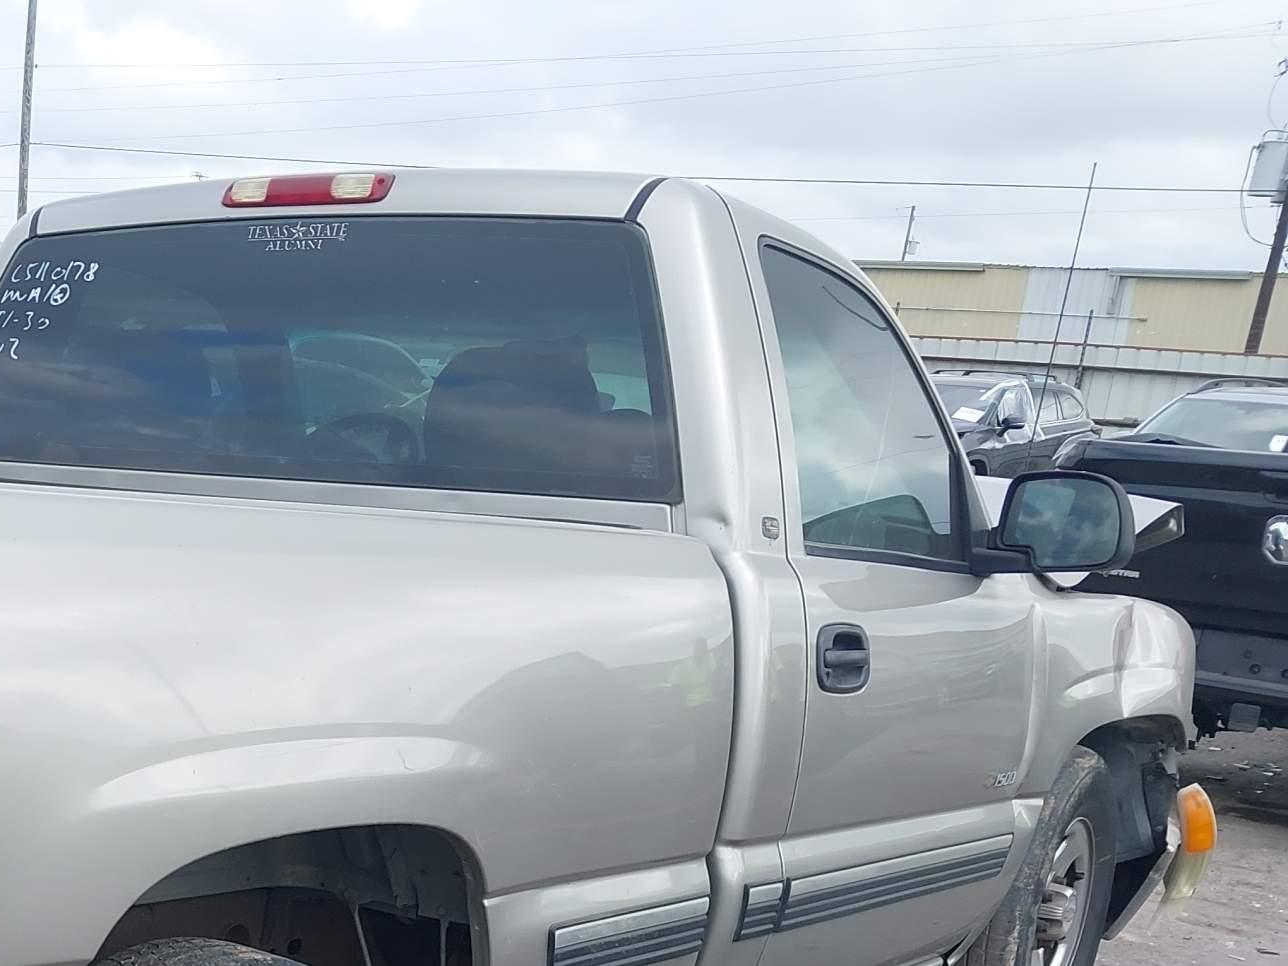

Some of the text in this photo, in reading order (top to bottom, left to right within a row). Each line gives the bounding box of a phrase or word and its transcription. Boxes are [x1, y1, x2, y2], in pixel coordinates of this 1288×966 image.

[248, 222, 350, 238] TEXAS STATE
[265, 240, 323, 251] ALUMNI
[993, 770, 1017, 787] 1500
